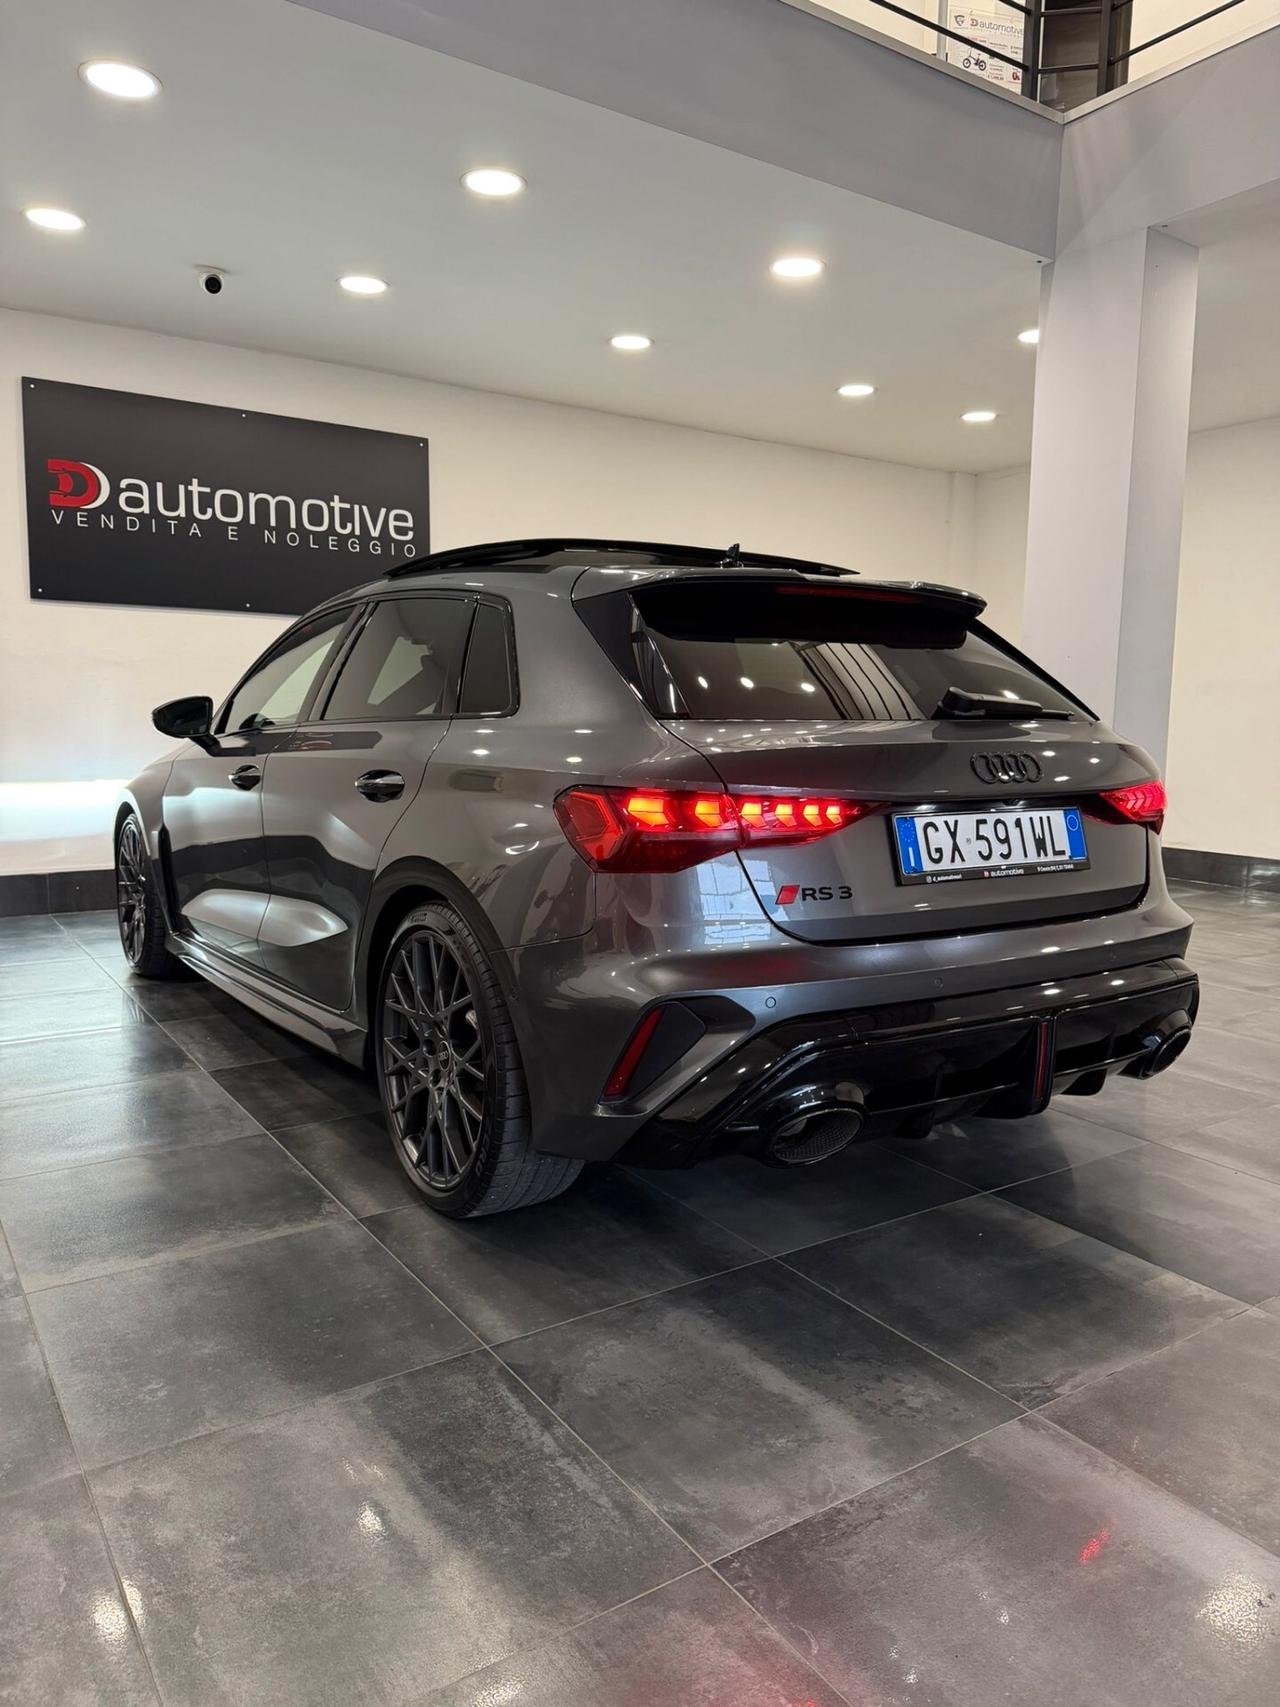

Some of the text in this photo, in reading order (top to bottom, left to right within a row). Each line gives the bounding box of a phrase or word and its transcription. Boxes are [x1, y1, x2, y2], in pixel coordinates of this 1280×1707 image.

[51, 509, 417, 559] VENDITA E NOLEGGIO
[118, 477, 414, 541] automotive
[801, 885, 853, 901] RS 3
